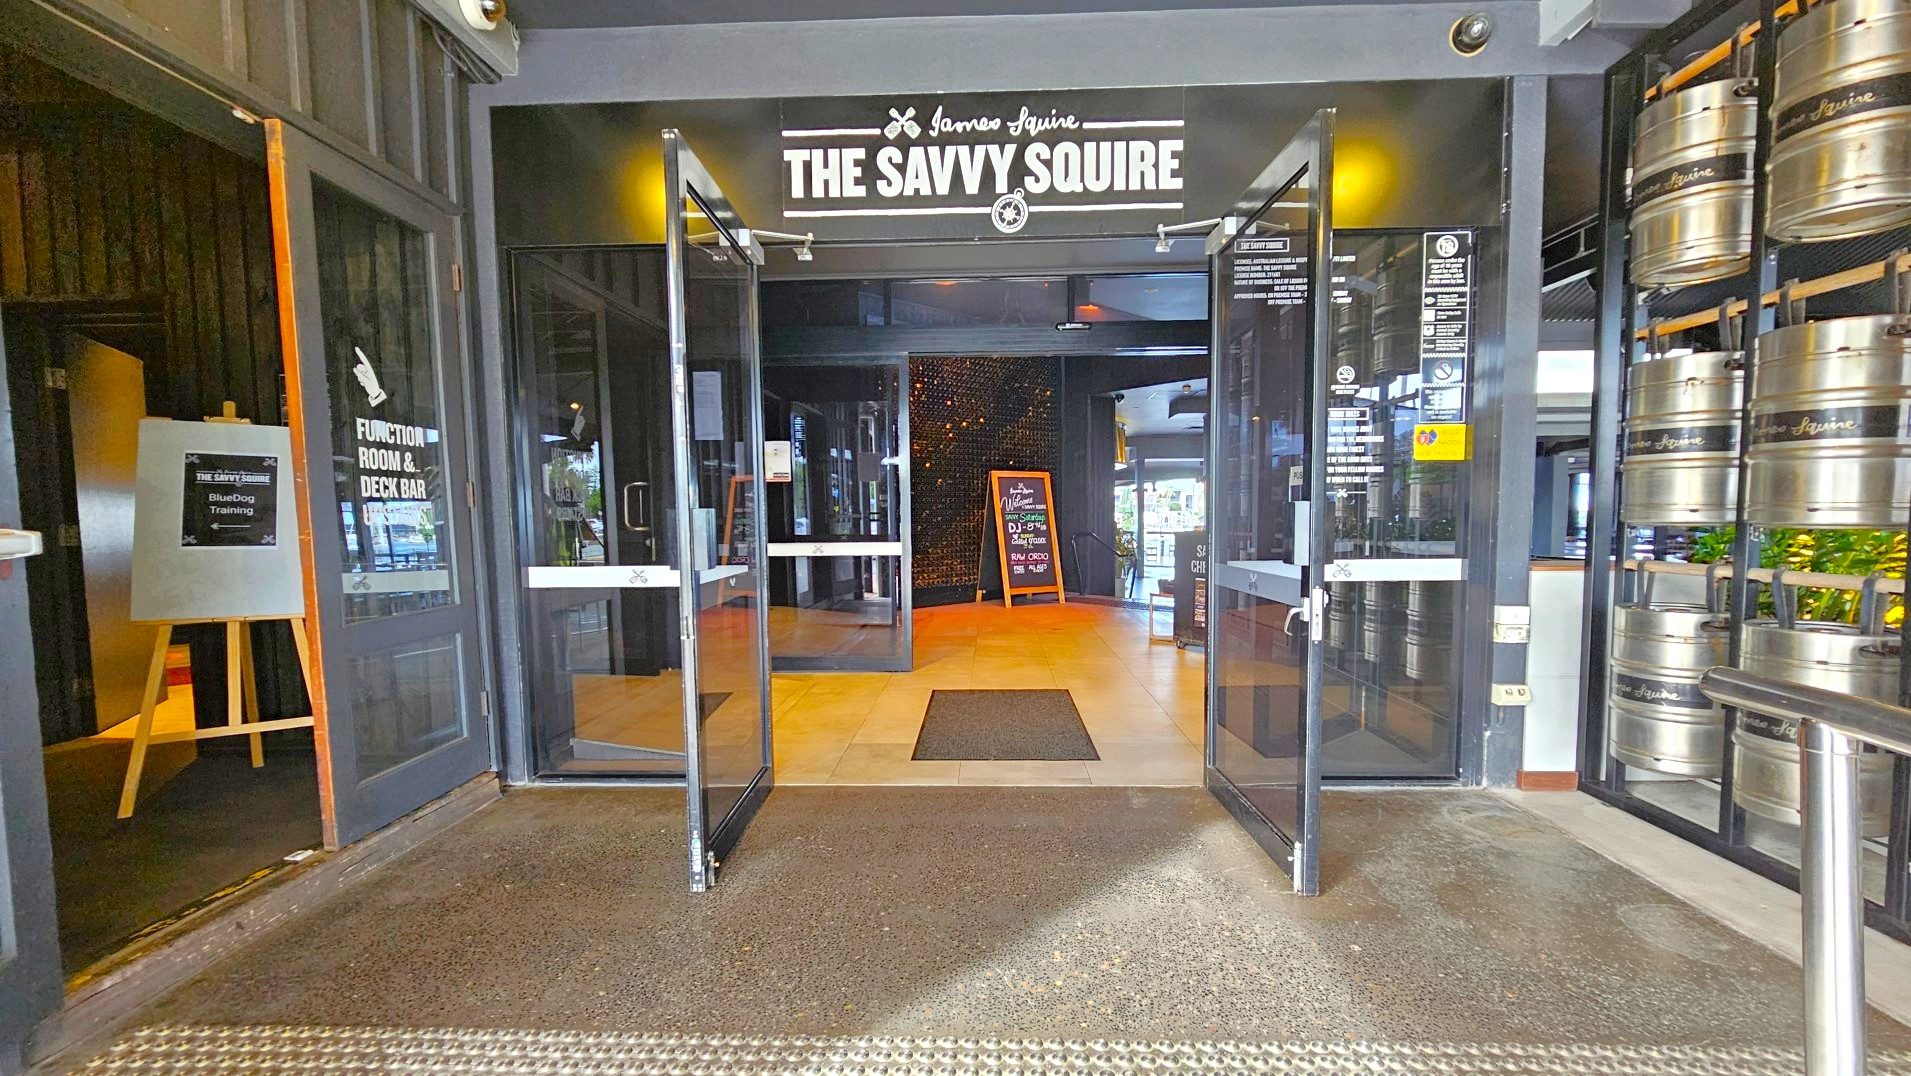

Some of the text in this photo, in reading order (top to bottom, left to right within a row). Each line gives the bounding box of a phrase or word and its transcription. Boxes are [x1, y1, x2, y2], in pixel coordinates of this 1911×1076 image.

[1809, 92, 1876, 121] Squire
[929, 104, 1080, 137] James Squire
[783, 139, 1184, 198] THE SAVVY SQUIRE
[1664, 167, 1715, 189] Squire
[355, 417, 425, 447] FUNCTION
[1792, 416, 1859, 436] Squire
[1653, 434, 1706, 449] Squire
[358, 447, 415, 473] ROOM &
[196, 473, 270, 483] THE SAVVY SQUIRE
[1293, 471, 1303, 480] PUS
[360, 475, 427, 499] DECK BAR
[208, 493, 255, 504] BlueDog
[1000, 493, 1033, 511] Welcome
[209, 506, 254, 516] Training
[362, 503, 428, 525] UPSTS
[1008, 522, 1021, 533] DJ
[1011, 553, 1025, 561] RAW
[1191, 560, 1206, 573] CHE
[1633, 684, 1681, 700] Squire
